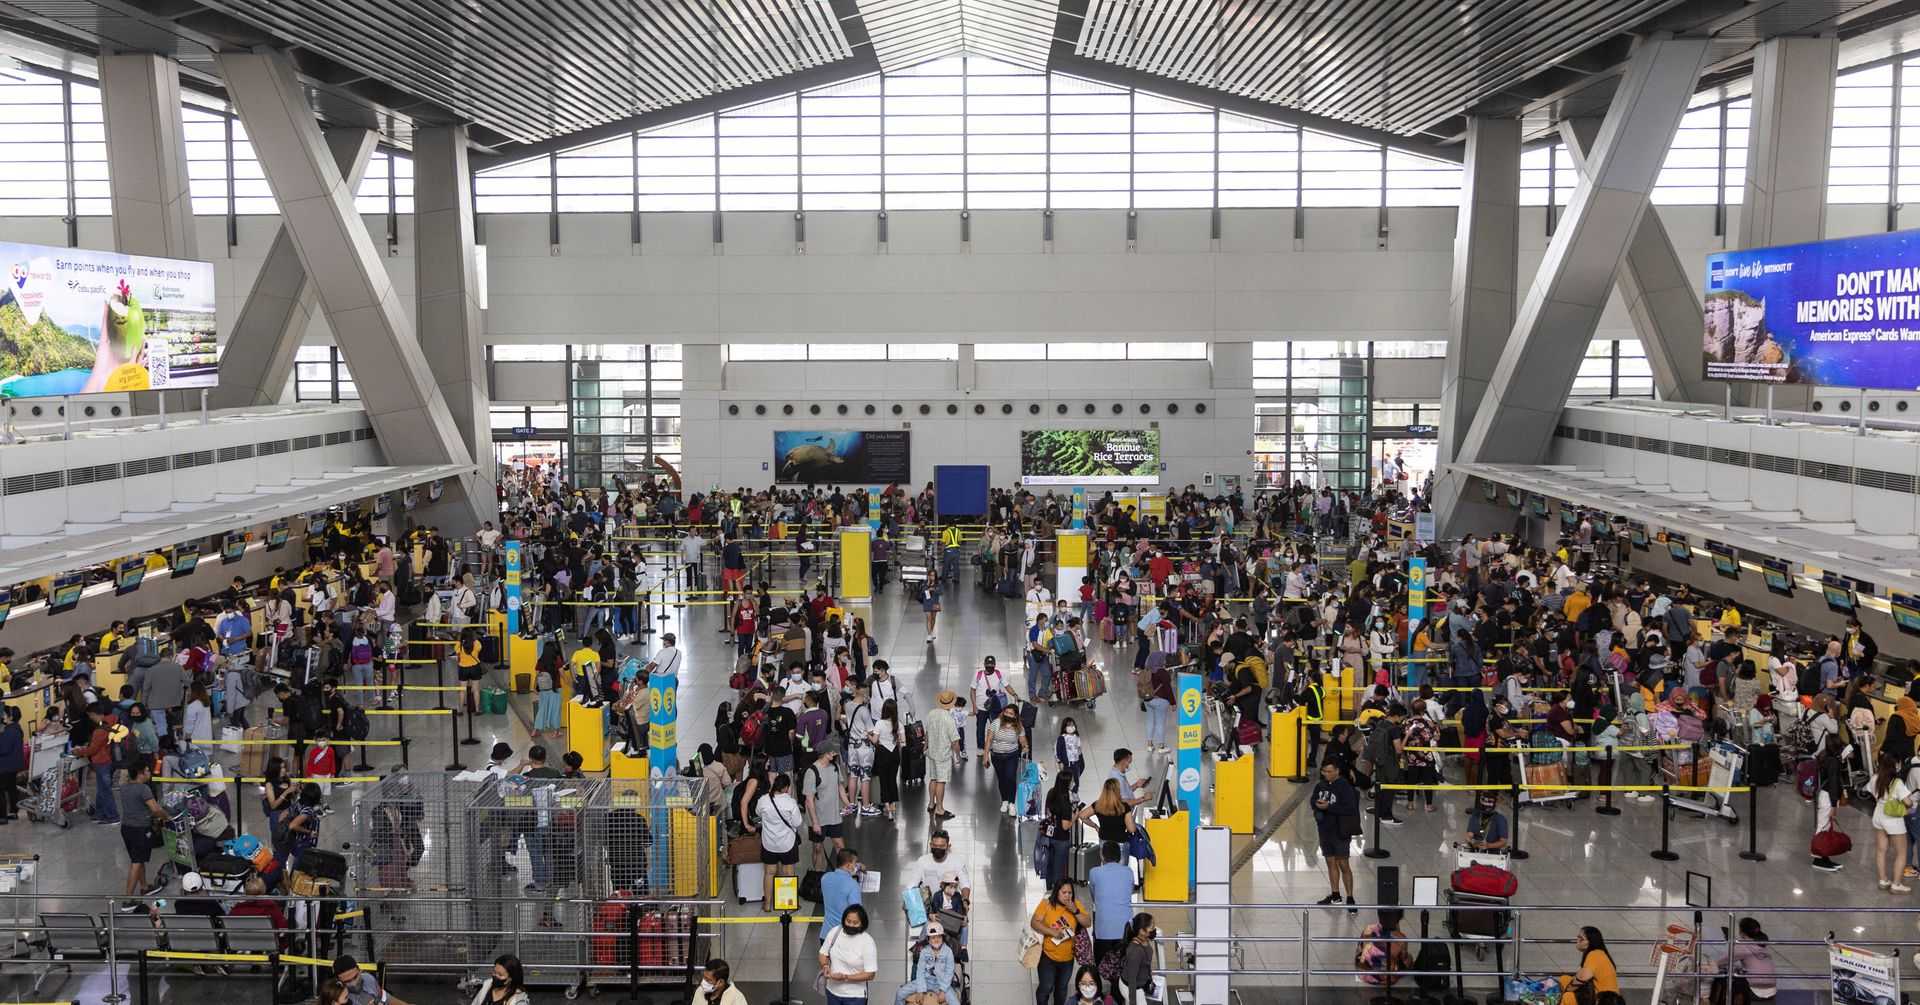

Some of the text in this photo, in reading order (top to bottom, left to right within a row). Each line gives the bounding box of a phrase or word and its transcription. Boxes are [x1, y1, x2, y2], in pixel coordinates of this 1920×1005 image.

[56, 259, 191, 281] Earn points when you fly and when you shop
[1837, 270, 1885, 296] DON'T
[1796, 295, 1920, 323] MEMORIES WITH
[1809, 329, 1842, 341] American
[1875, 328, 1899, 341] Cards
[1106, 443, 1141, 452] Banaue
[1093, 452, 1154, 461] Rice Terraces
[1187, 699, 1196, 713] 3
[1184, 731, 1198, 739] BAG
